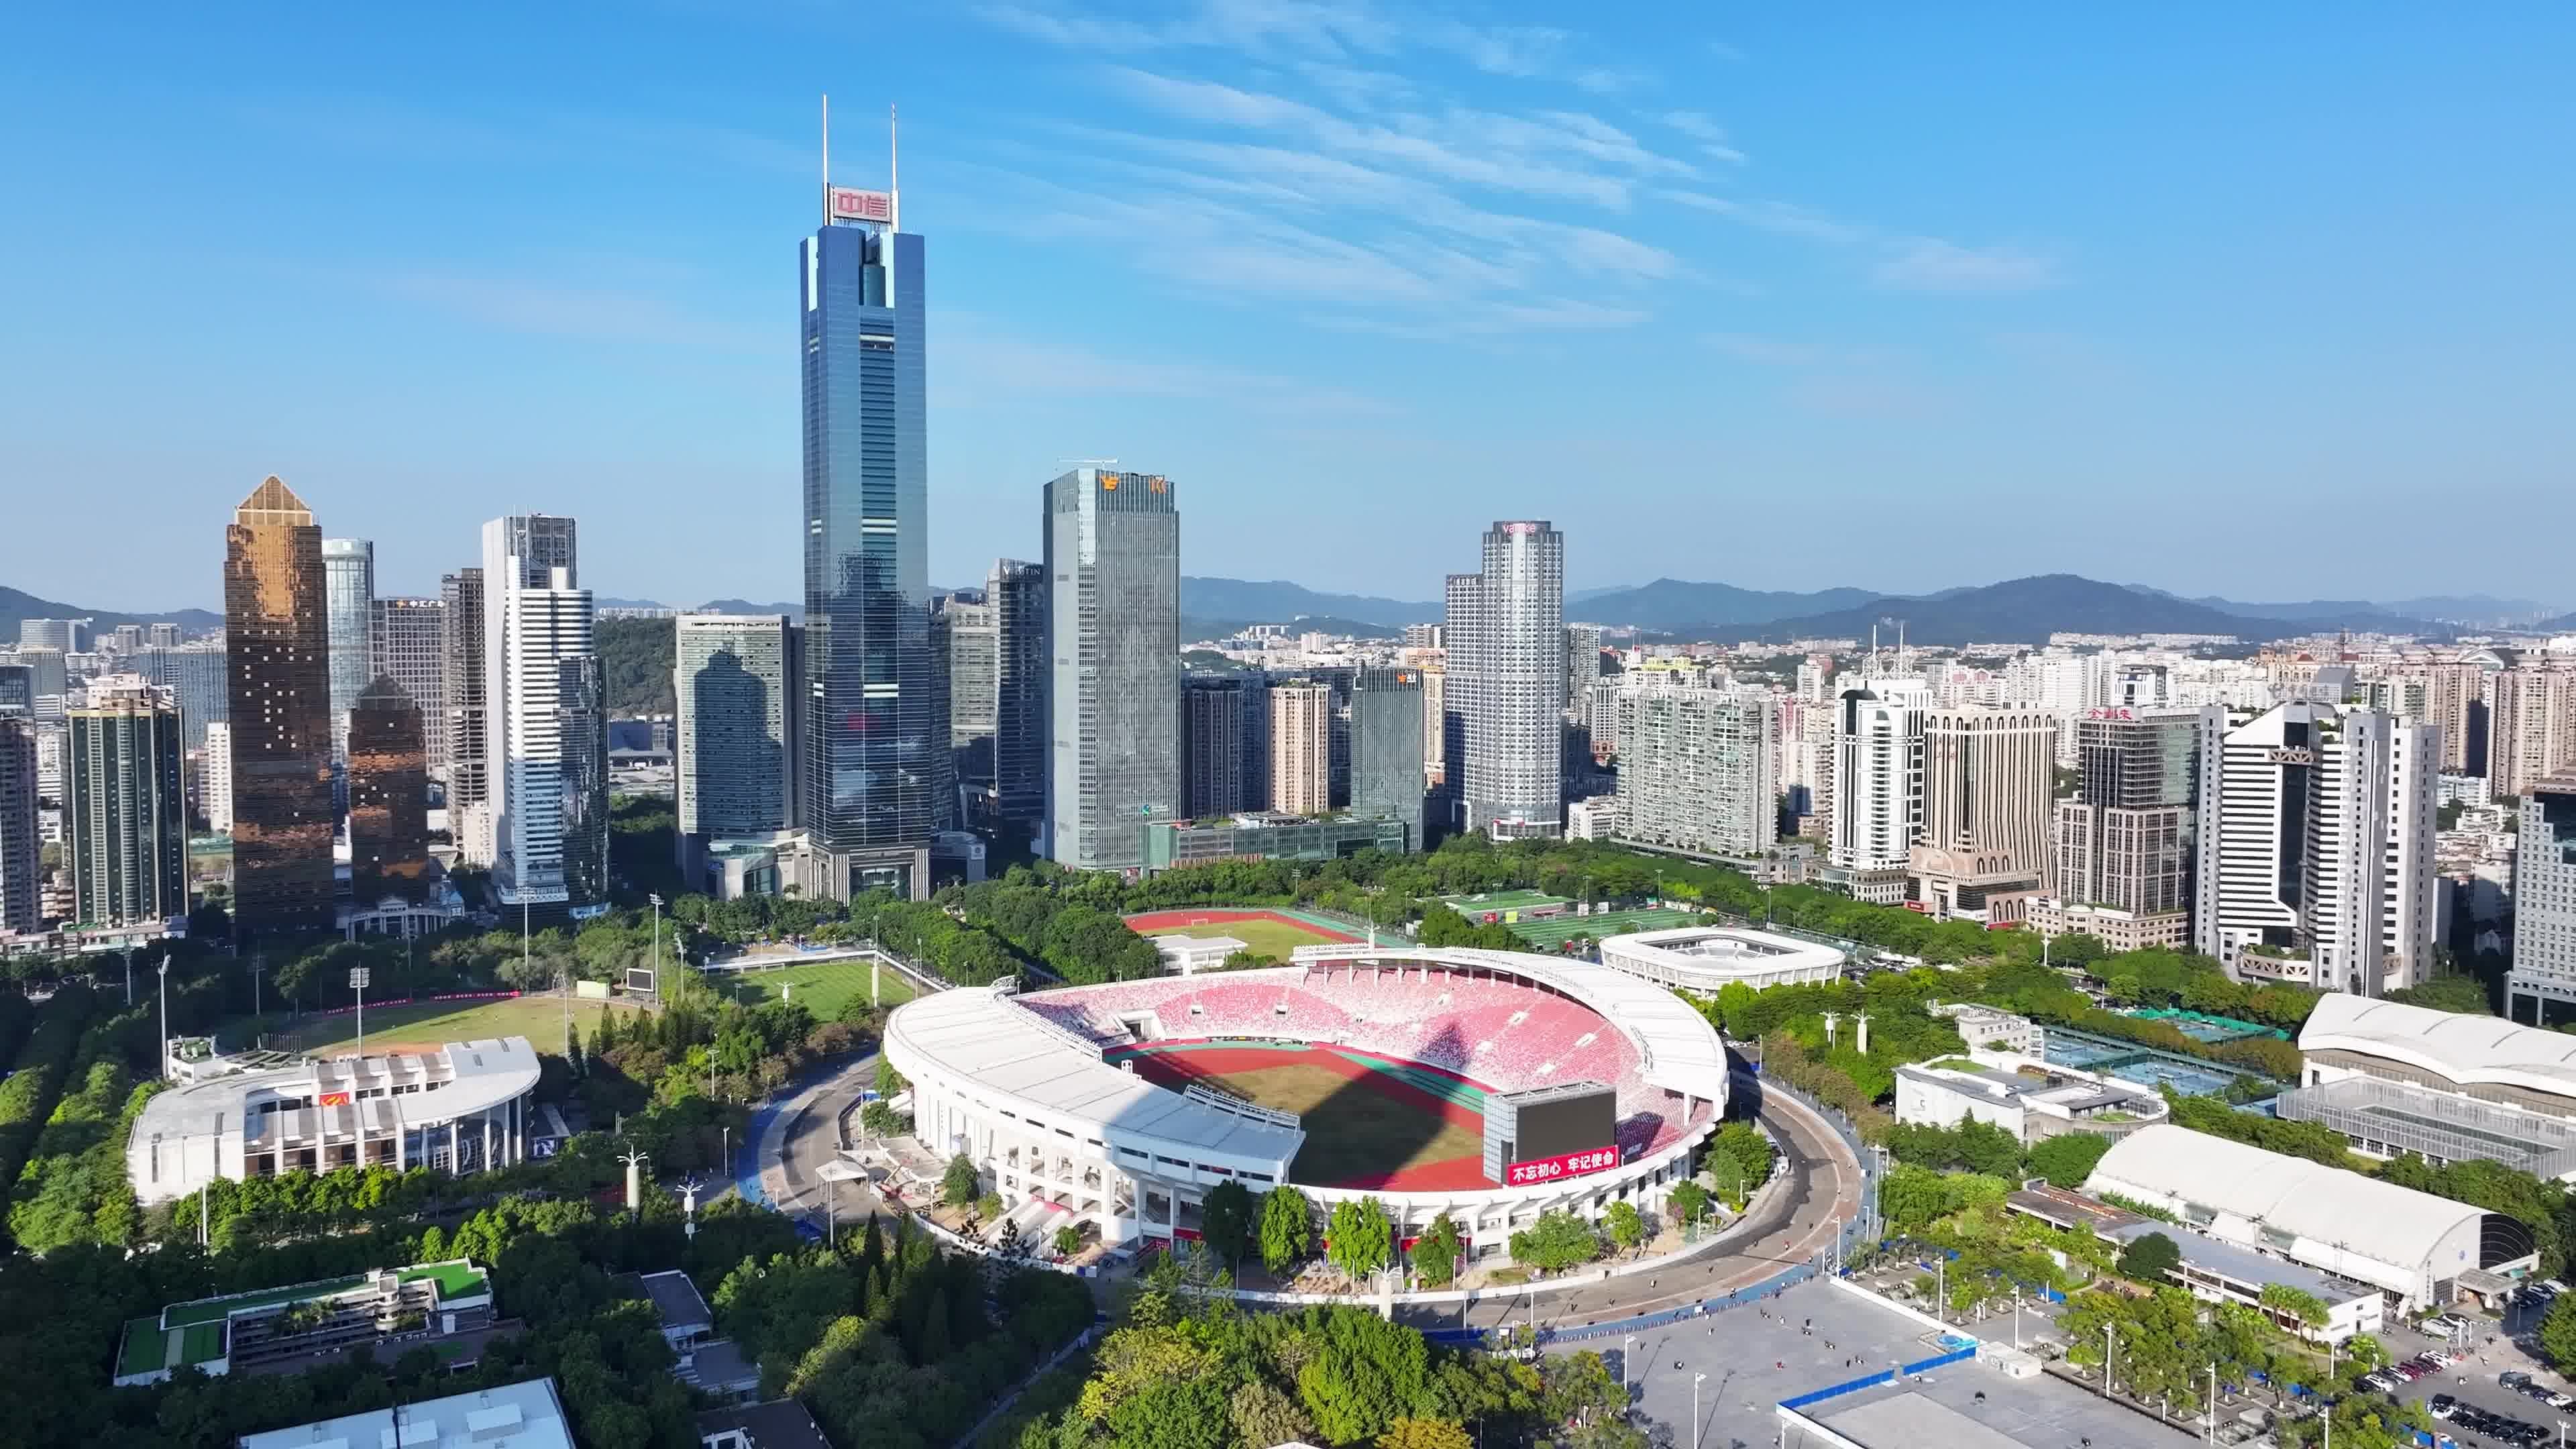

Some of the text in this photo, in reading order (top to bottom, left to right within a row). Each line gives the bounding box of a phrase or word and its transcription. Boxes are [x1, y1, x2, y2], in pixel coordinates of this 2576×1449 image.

[837, 193, 887, 216] 中信
[1513, 1151, 1614, 1182] 不忘初心 牢记使命
